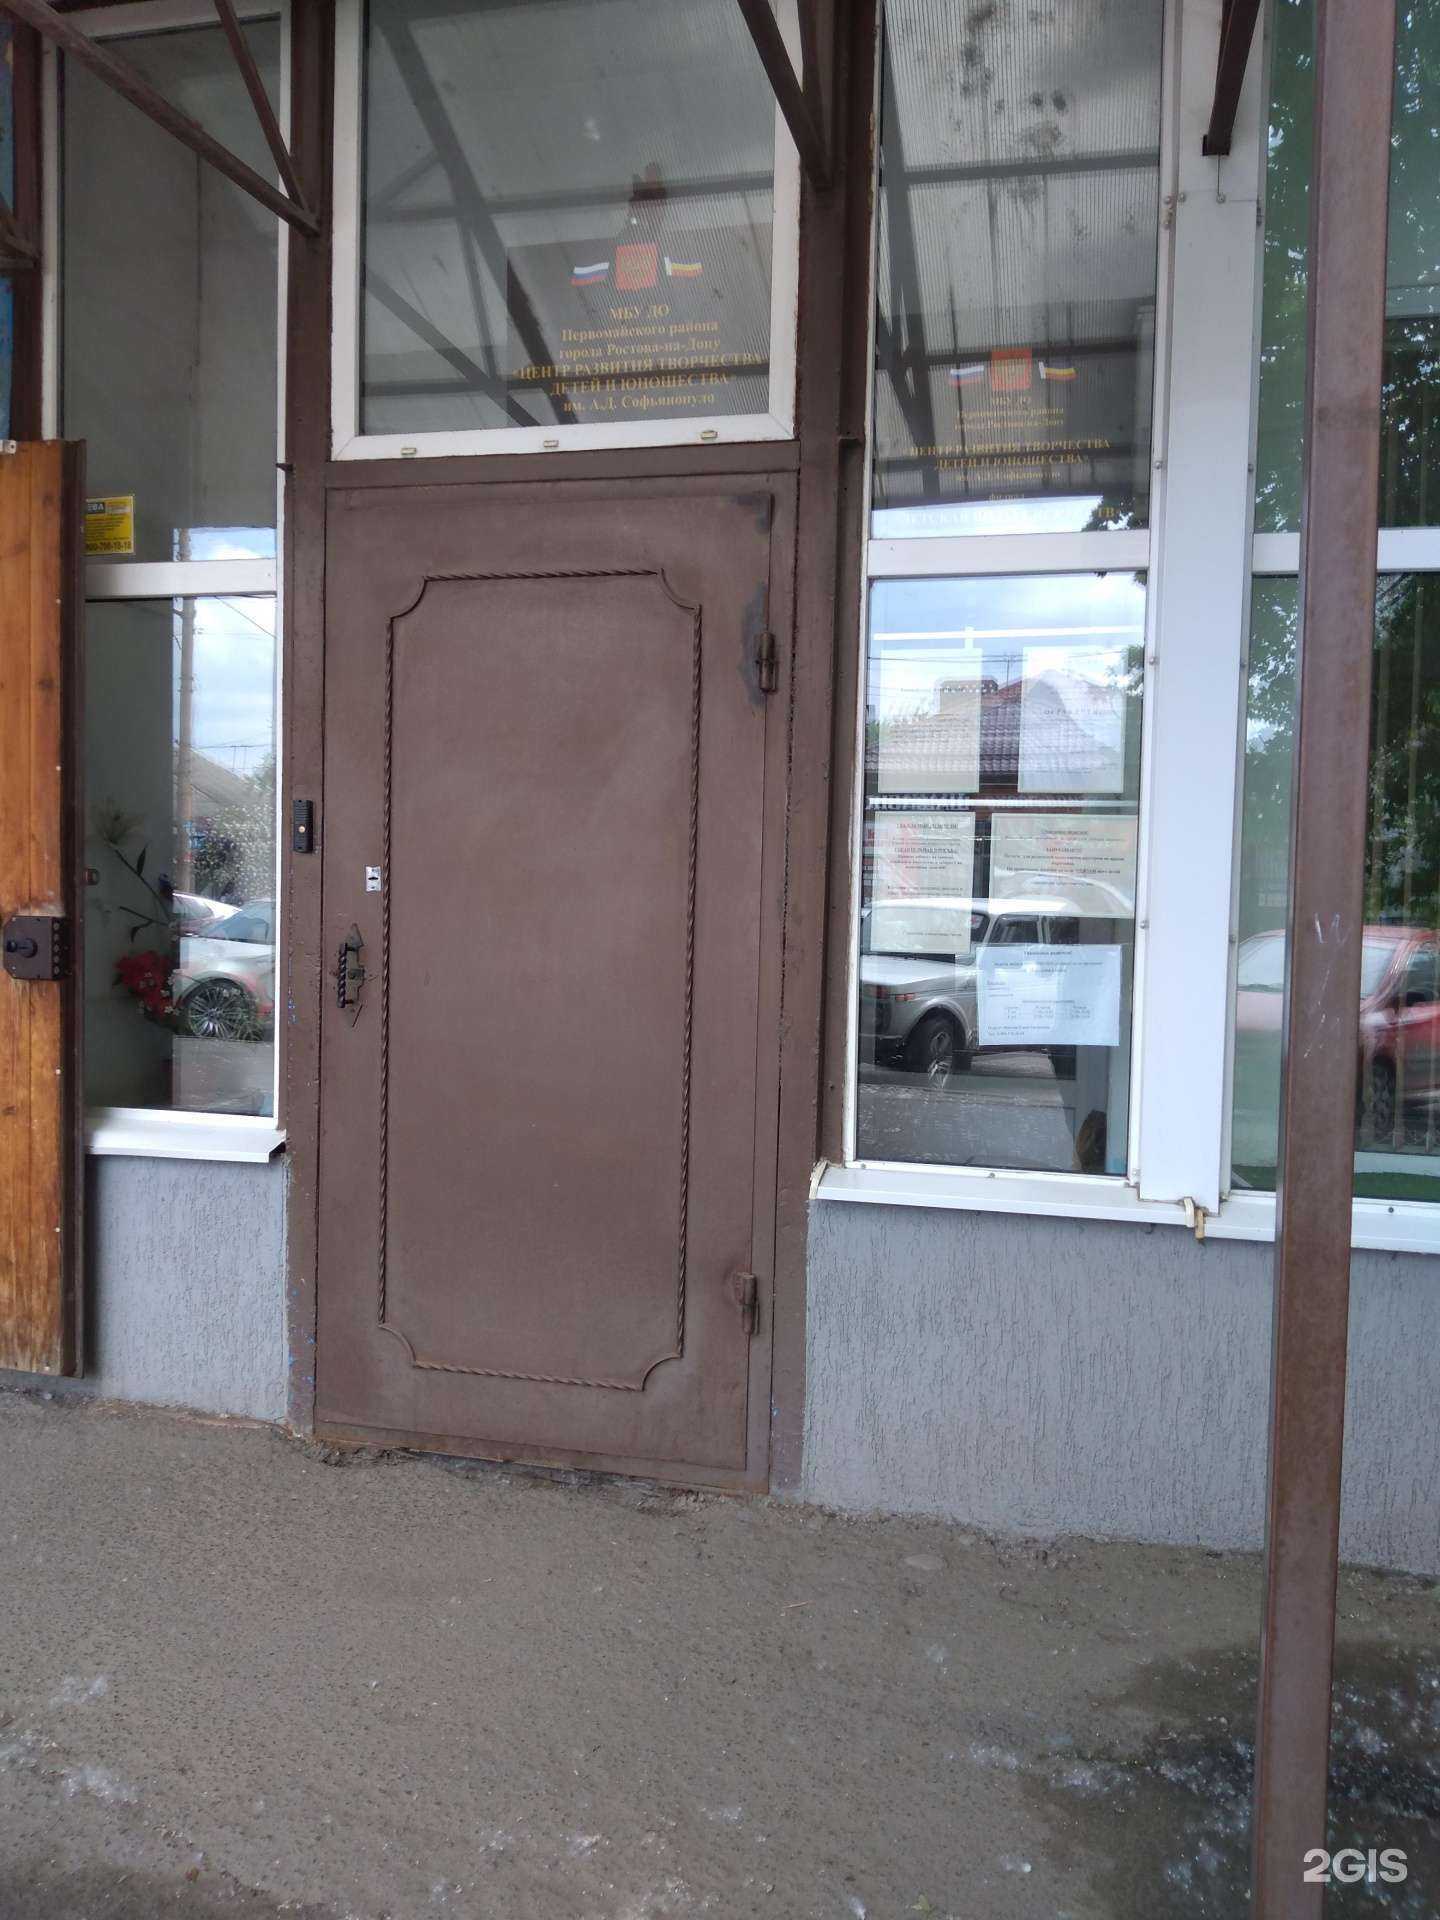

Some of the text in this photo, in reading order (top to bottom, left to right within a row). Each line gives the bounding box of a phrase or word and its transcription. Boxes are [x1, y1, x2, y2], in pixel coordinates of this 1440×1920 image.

[646, 303, 671, 319] ДО
[560, 319, 720, 342] Первомайского района
[607, 336, 721, 356] Ростова-на-Дону
[575, 360, 653, 377] РАЗВИТИЯ
[549, 378, 604, 397] ДЕТЕЙ
